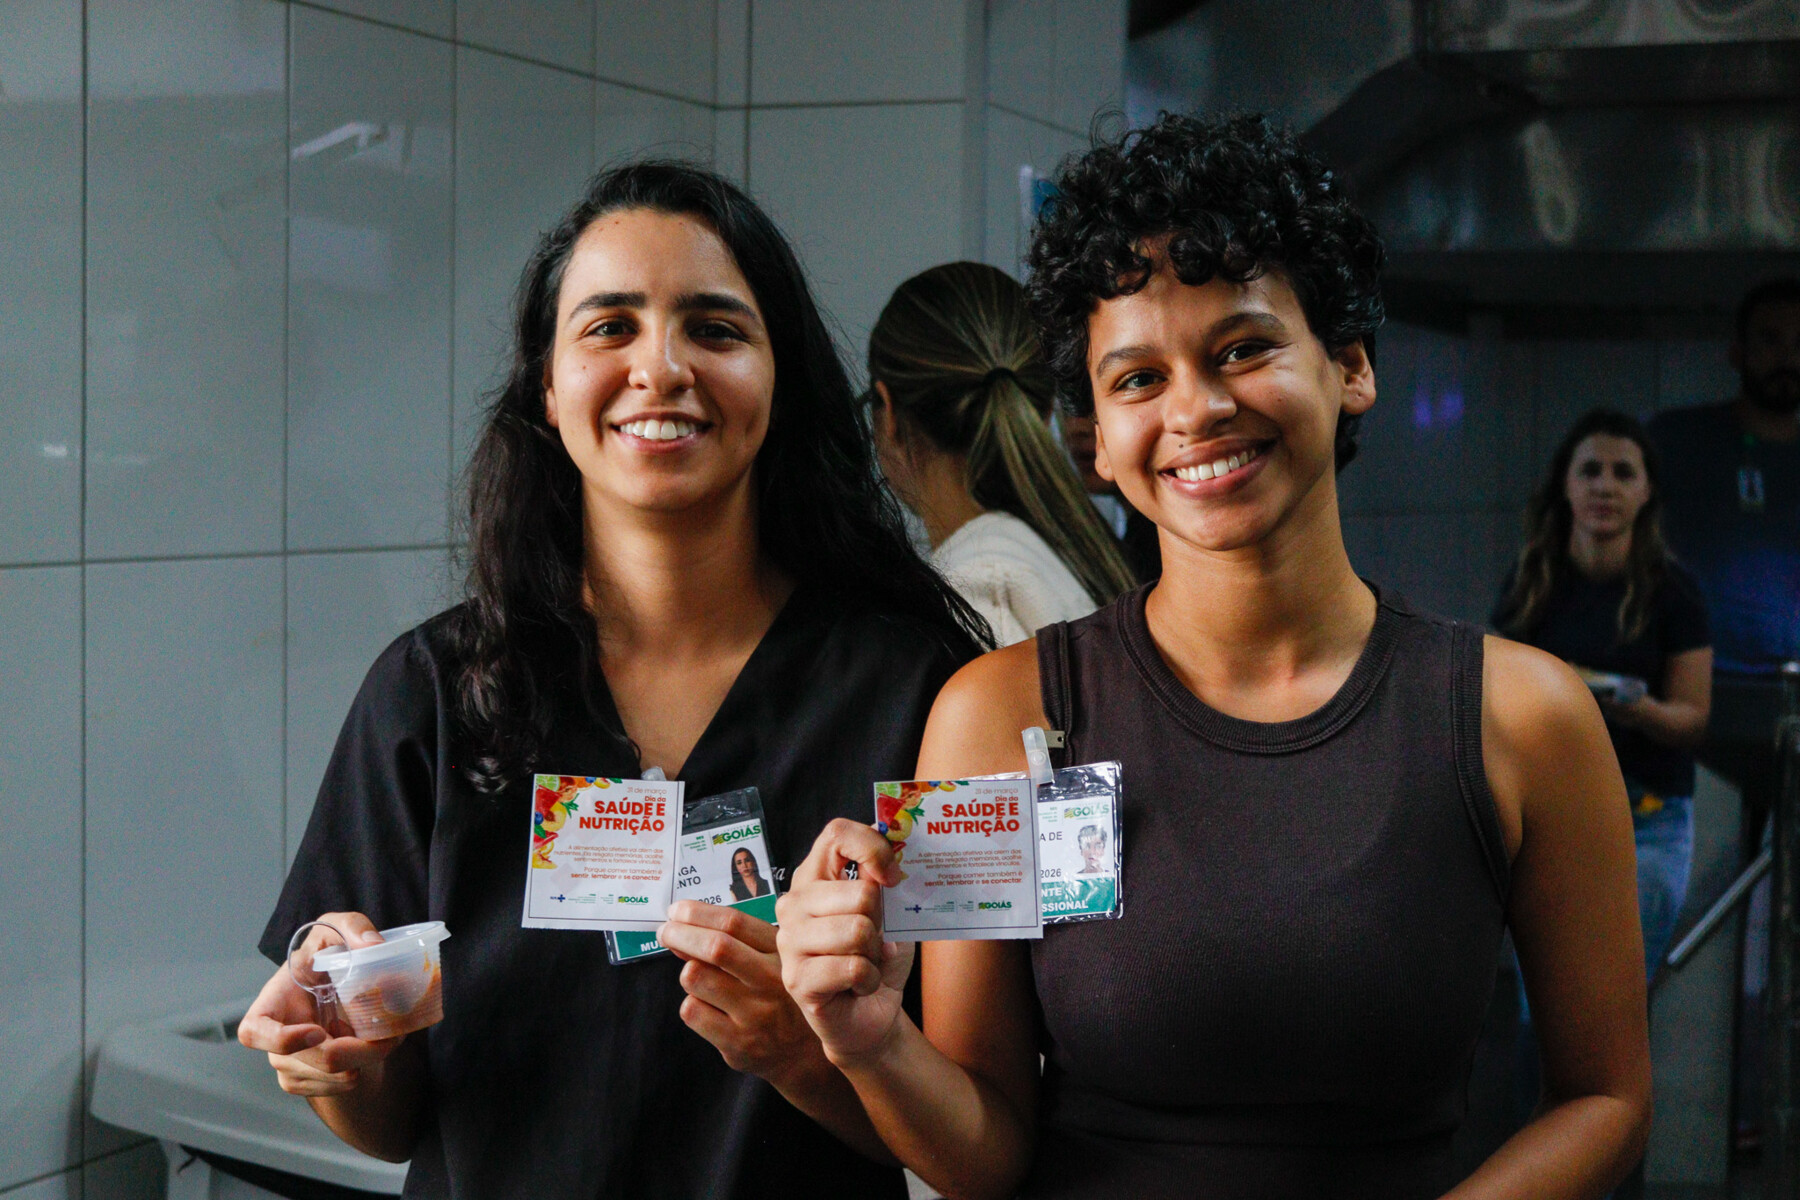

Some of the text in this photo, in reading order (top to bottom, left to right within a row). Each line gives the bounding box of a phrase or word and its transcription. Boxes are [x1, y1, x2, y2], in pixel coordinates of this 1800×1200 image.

[644, 787, 667, 795] março
[994, 787, 1018, 795] março
[594, 797, 666, 817] SAÚDE E
[942, 798, 1019, 818] SAÚDE E
[579, 815, 665, 836] NUTRIÇÃO
[927, 816, 1020, 837] NUTRIÇÃO
[722, 825, 761, 842] GOIÁS
[1049, 831, 1063, 841] DE
[584, 866, 606, 874] Porque
[629, 867, 657, 875] também
[1040, 869, 1061, 878] 2026
[676, 876, 701, 889] NTO
[624, 895, 649, 904] GOIÁS
[698, 895, 722, 904] 026
[984, 900, 1012, 909] GOIÁS
[640, 941, 662, 952] MU
